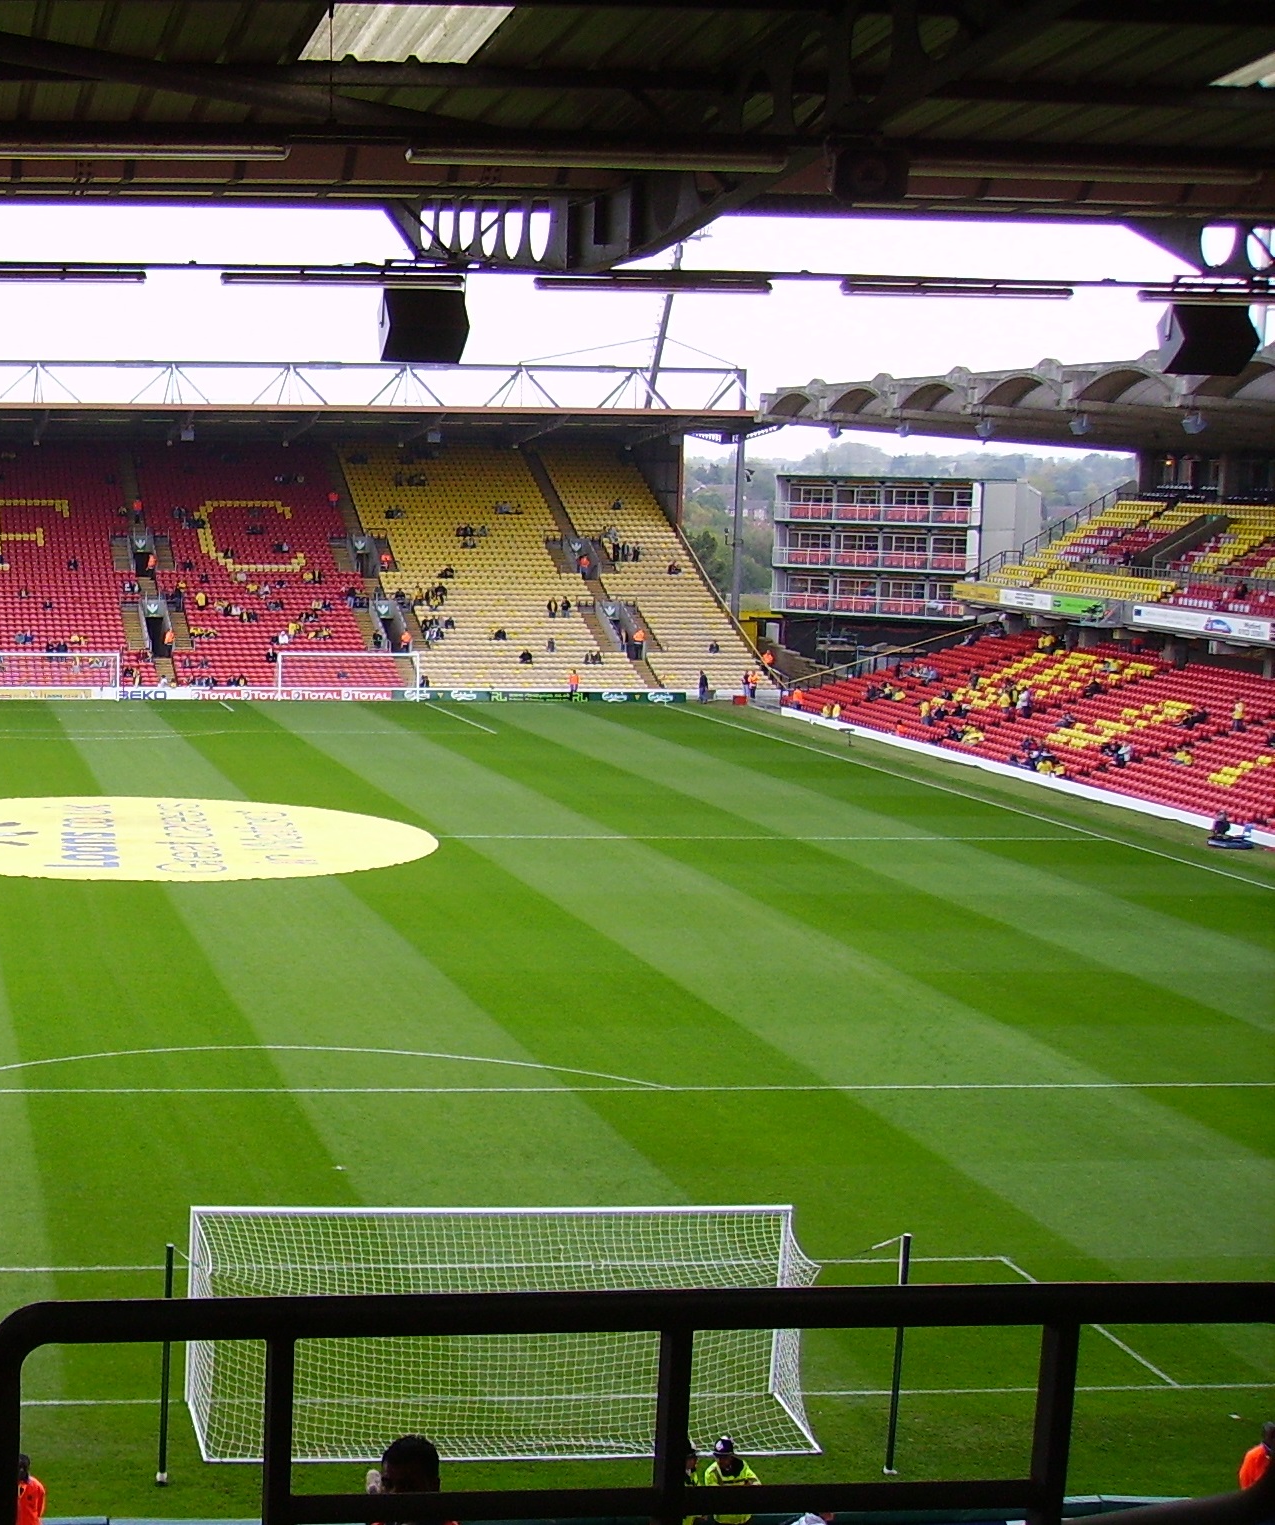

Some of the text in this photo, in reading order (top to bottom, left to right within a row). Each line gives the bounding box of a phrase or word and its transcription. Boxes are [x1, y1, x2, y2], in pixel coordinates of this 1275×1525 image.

[194, 501, 306, 572] C
[119, 691, 167, 700] BEKO
[202, 690, 242, 700] TOTAL
[251, 690, 292, 700] TOTAL
[302, 690, 341, 700] TOTAL
[350, 690, 392, 700] TOTAL
